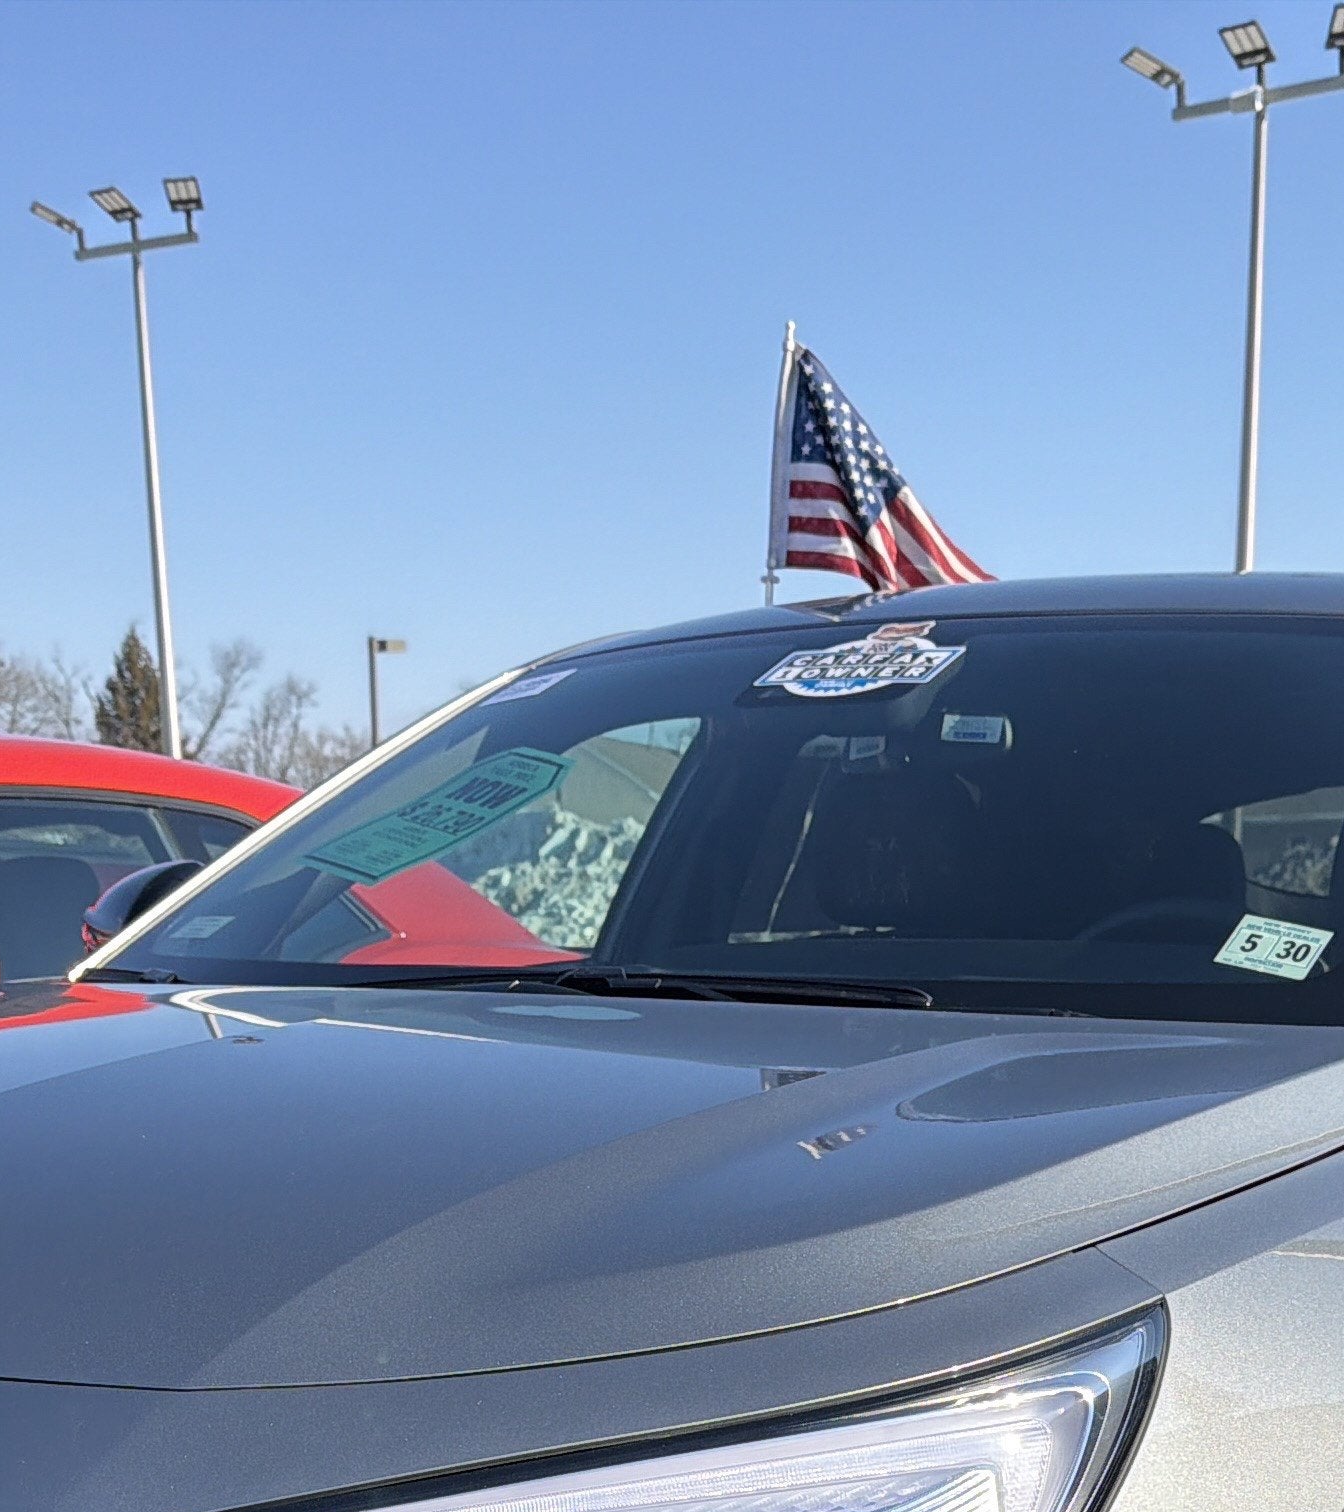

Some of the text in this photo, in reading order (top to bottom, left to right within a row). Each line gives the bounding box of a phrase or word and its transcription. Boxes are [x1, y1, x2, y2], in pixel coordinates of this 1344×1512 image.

[791, 651, 944, 667] CARFAX
[801, 666, 927, 679] OWNER
[1239, 933, 1312, 962] 5 30
